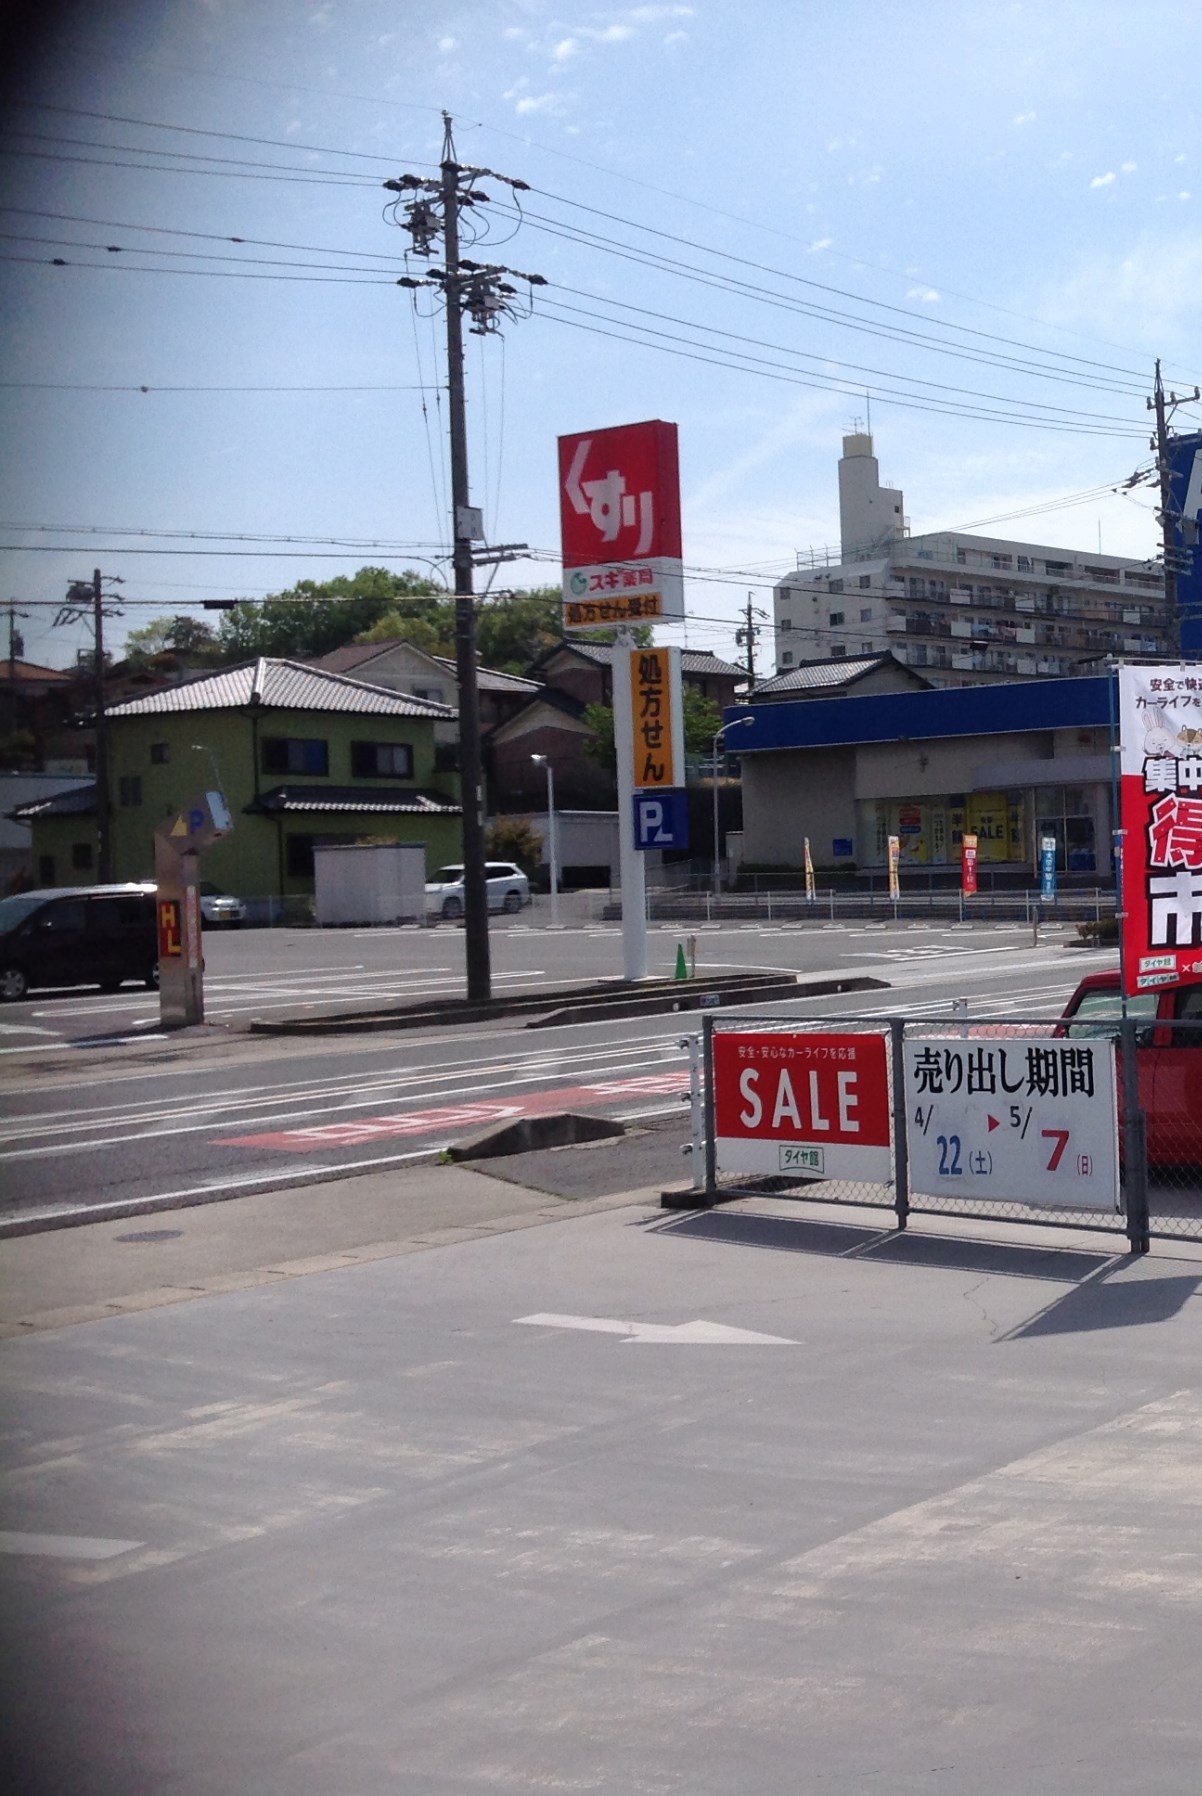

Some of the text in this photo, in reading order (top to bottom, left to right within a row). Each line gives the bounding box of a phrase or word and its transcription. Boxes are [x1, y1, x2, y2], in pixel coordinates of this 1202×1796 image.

[565, 440, 653, 555] くすり
[589, 568, 653, 591] スギ薬局
[639, 655, 665, 782] 処方せん
[190, 810, 205, 831] P
[640, 801, 662, 842] P
[971, 825, 1003, 840] SALE
[914, 1047, 1094, 1097] 売り出し期間
[739, 1068, 860, 1132] SALE
[784, 1148, 819, 1167] タイヤ館
[936, 1134, 963, 1175] 22
[1041, 1129, 1069, 1171] 7
